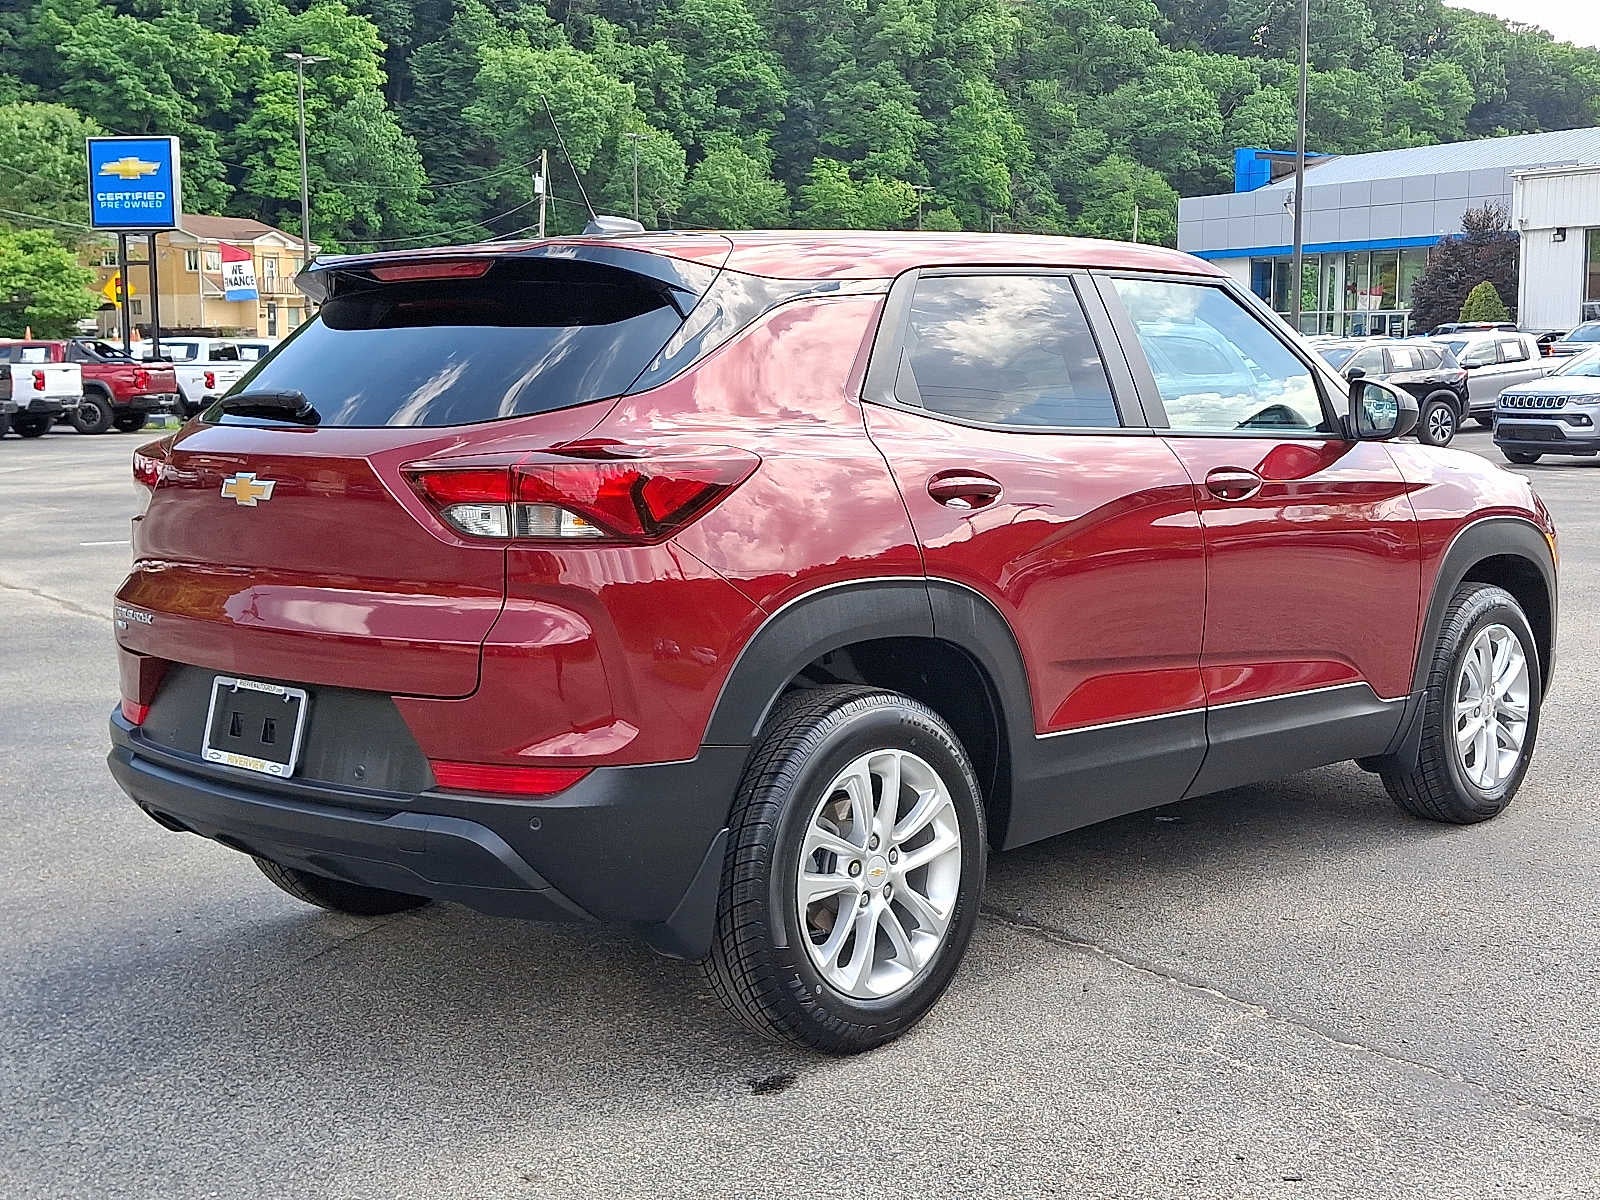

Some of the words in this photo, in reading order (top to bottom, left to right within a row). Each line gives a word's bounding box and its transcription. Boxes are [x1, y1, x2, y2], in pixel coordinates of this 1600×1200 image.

[96, 191, 166, 201] CERTIFIED
[100, 200, 162, 209] PRE-OWNED
[226, 754, 266, 770] RIVERVIEW
